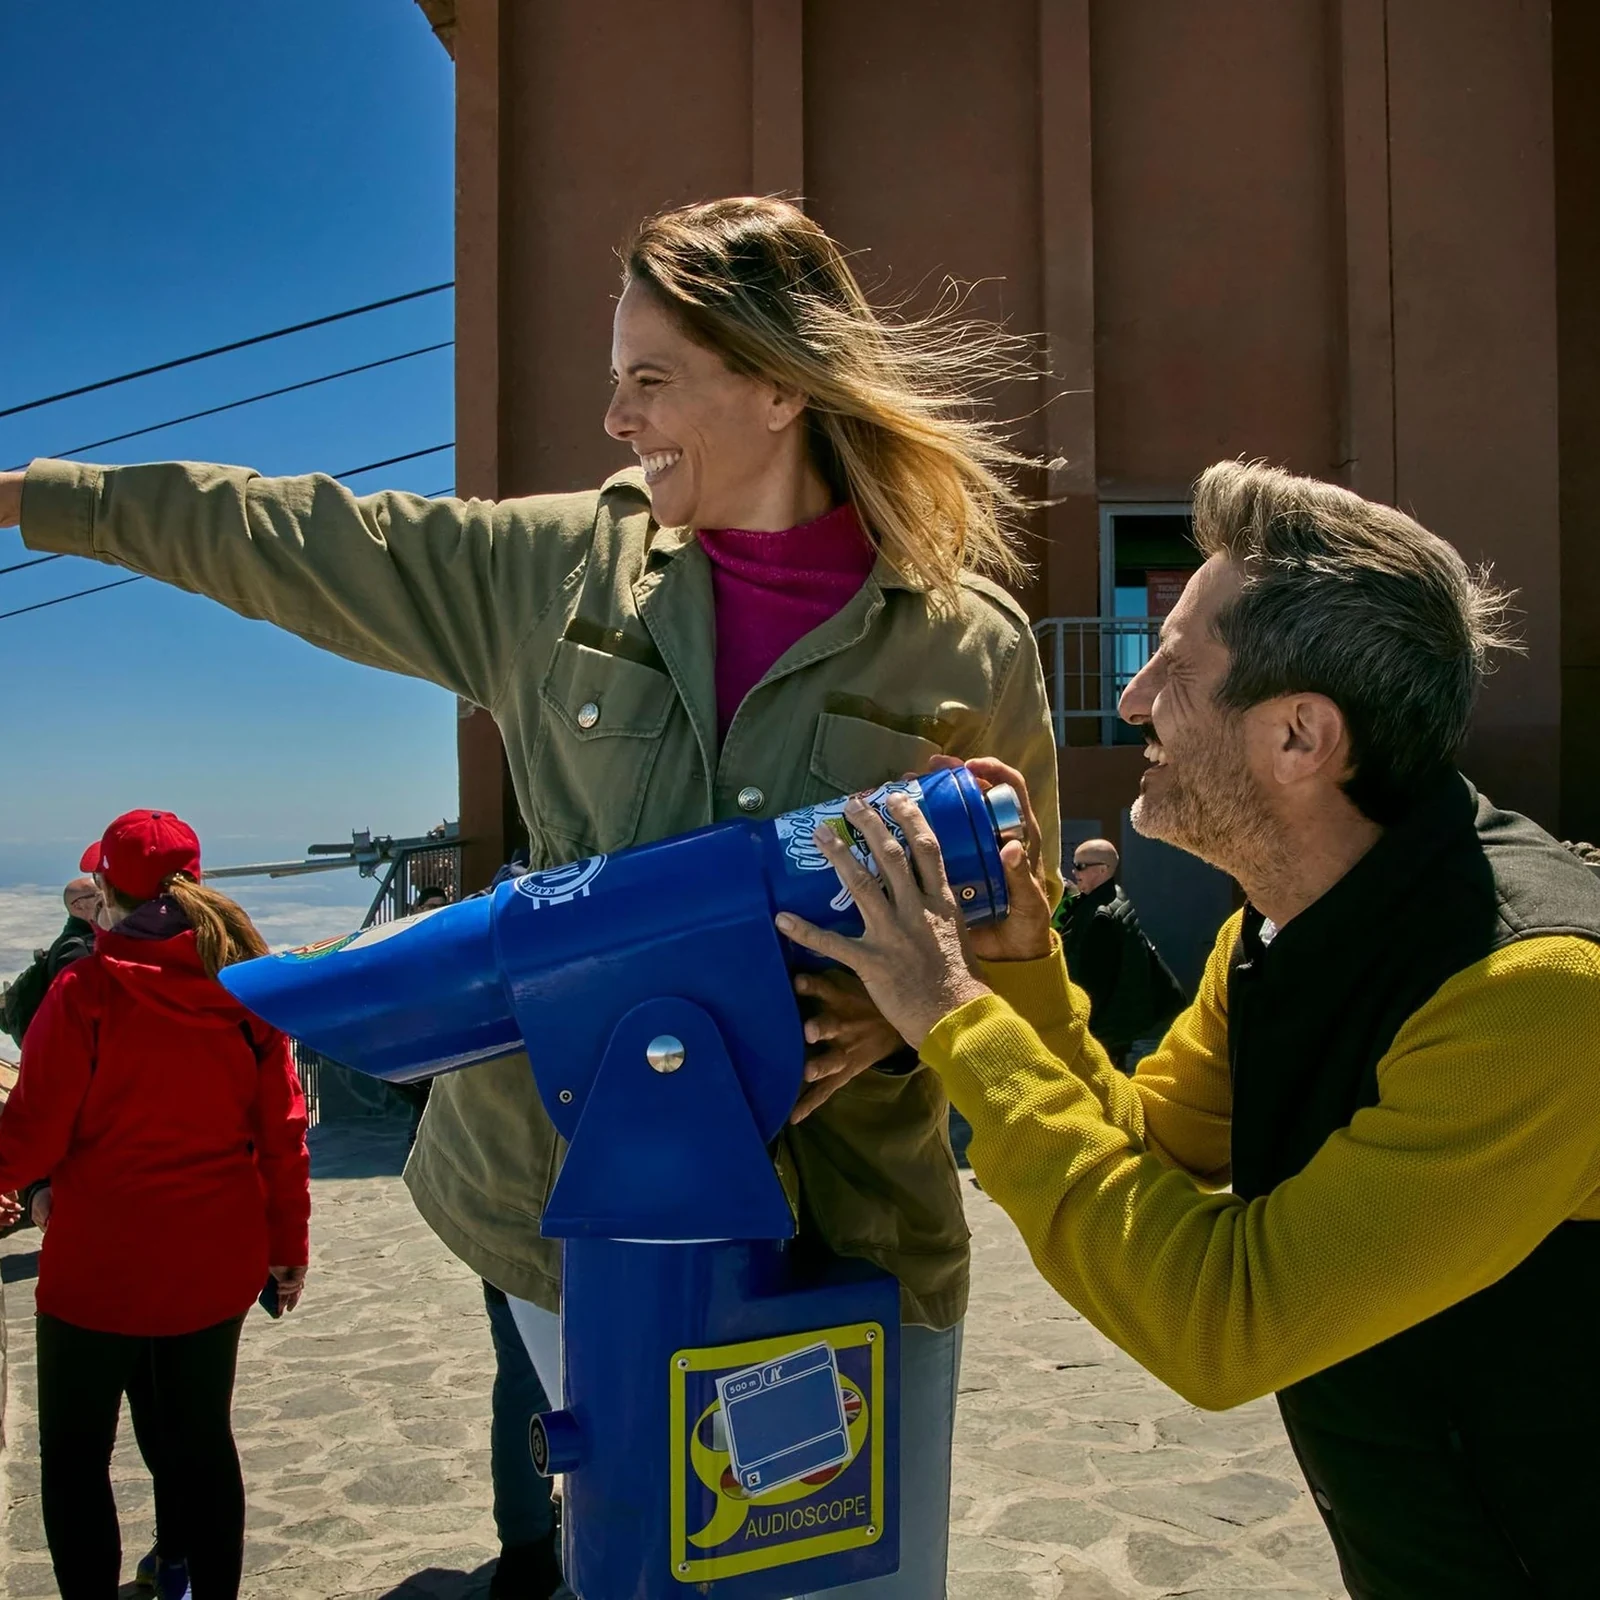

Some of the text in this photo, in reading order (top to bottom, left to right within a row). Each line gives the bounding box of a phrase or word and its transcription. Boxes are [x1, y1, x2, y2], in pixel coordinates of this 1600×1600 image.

[729, 1379, 757, 1394] 500 m
[745, 1495, 866, 1540] AUDIOSCOPE
